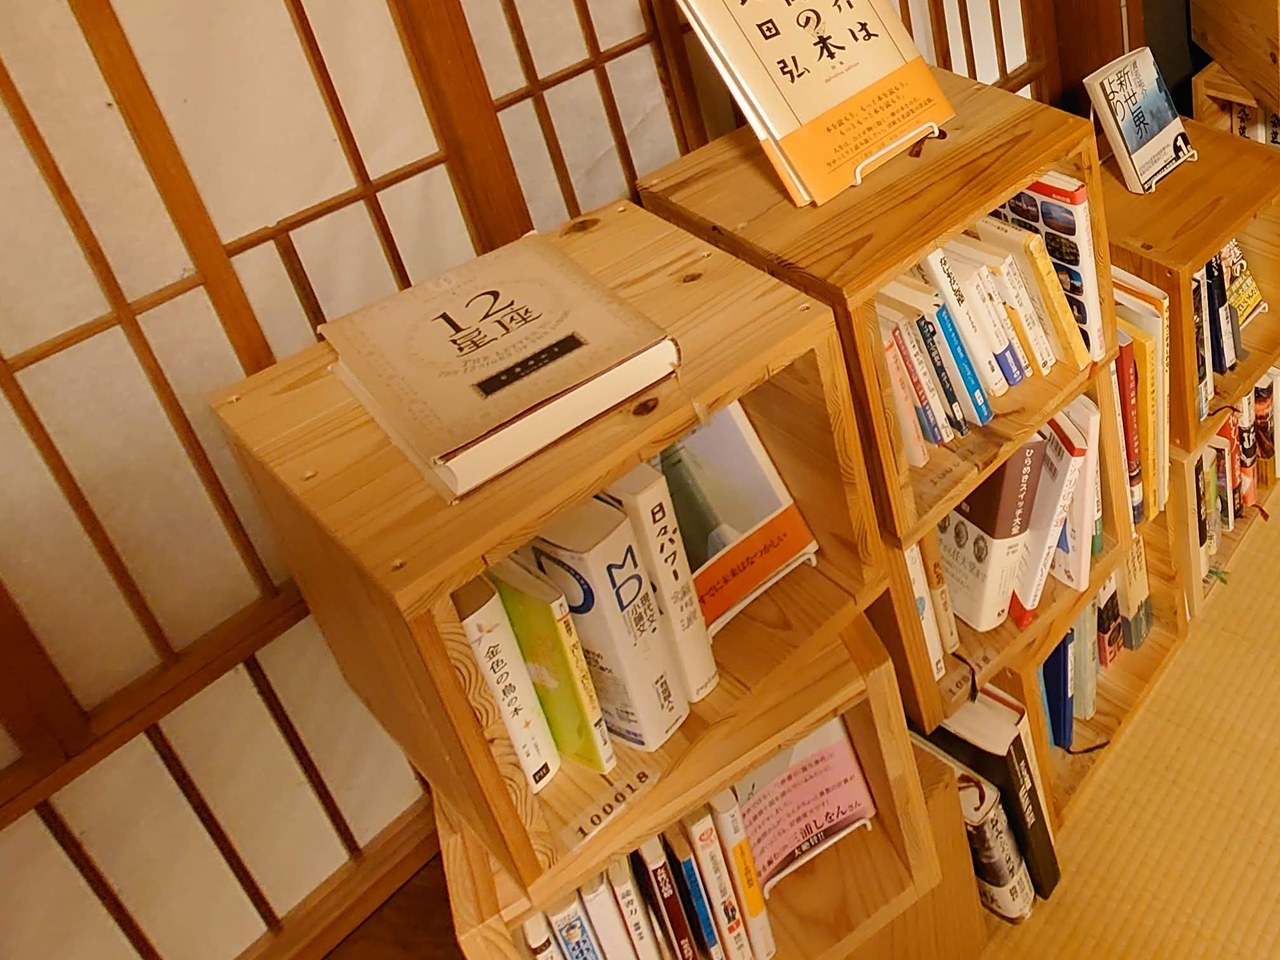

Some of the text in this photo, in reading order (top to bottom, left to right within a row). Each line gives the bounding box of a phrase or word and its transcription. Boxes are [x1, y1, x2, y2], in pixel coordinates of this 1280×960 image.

[431, 288, 515, 338] 12
[450, 304, 543, 358] 星座
[948, 655, 991, 696] 10018
[576, 770, 649, 839] 100018
